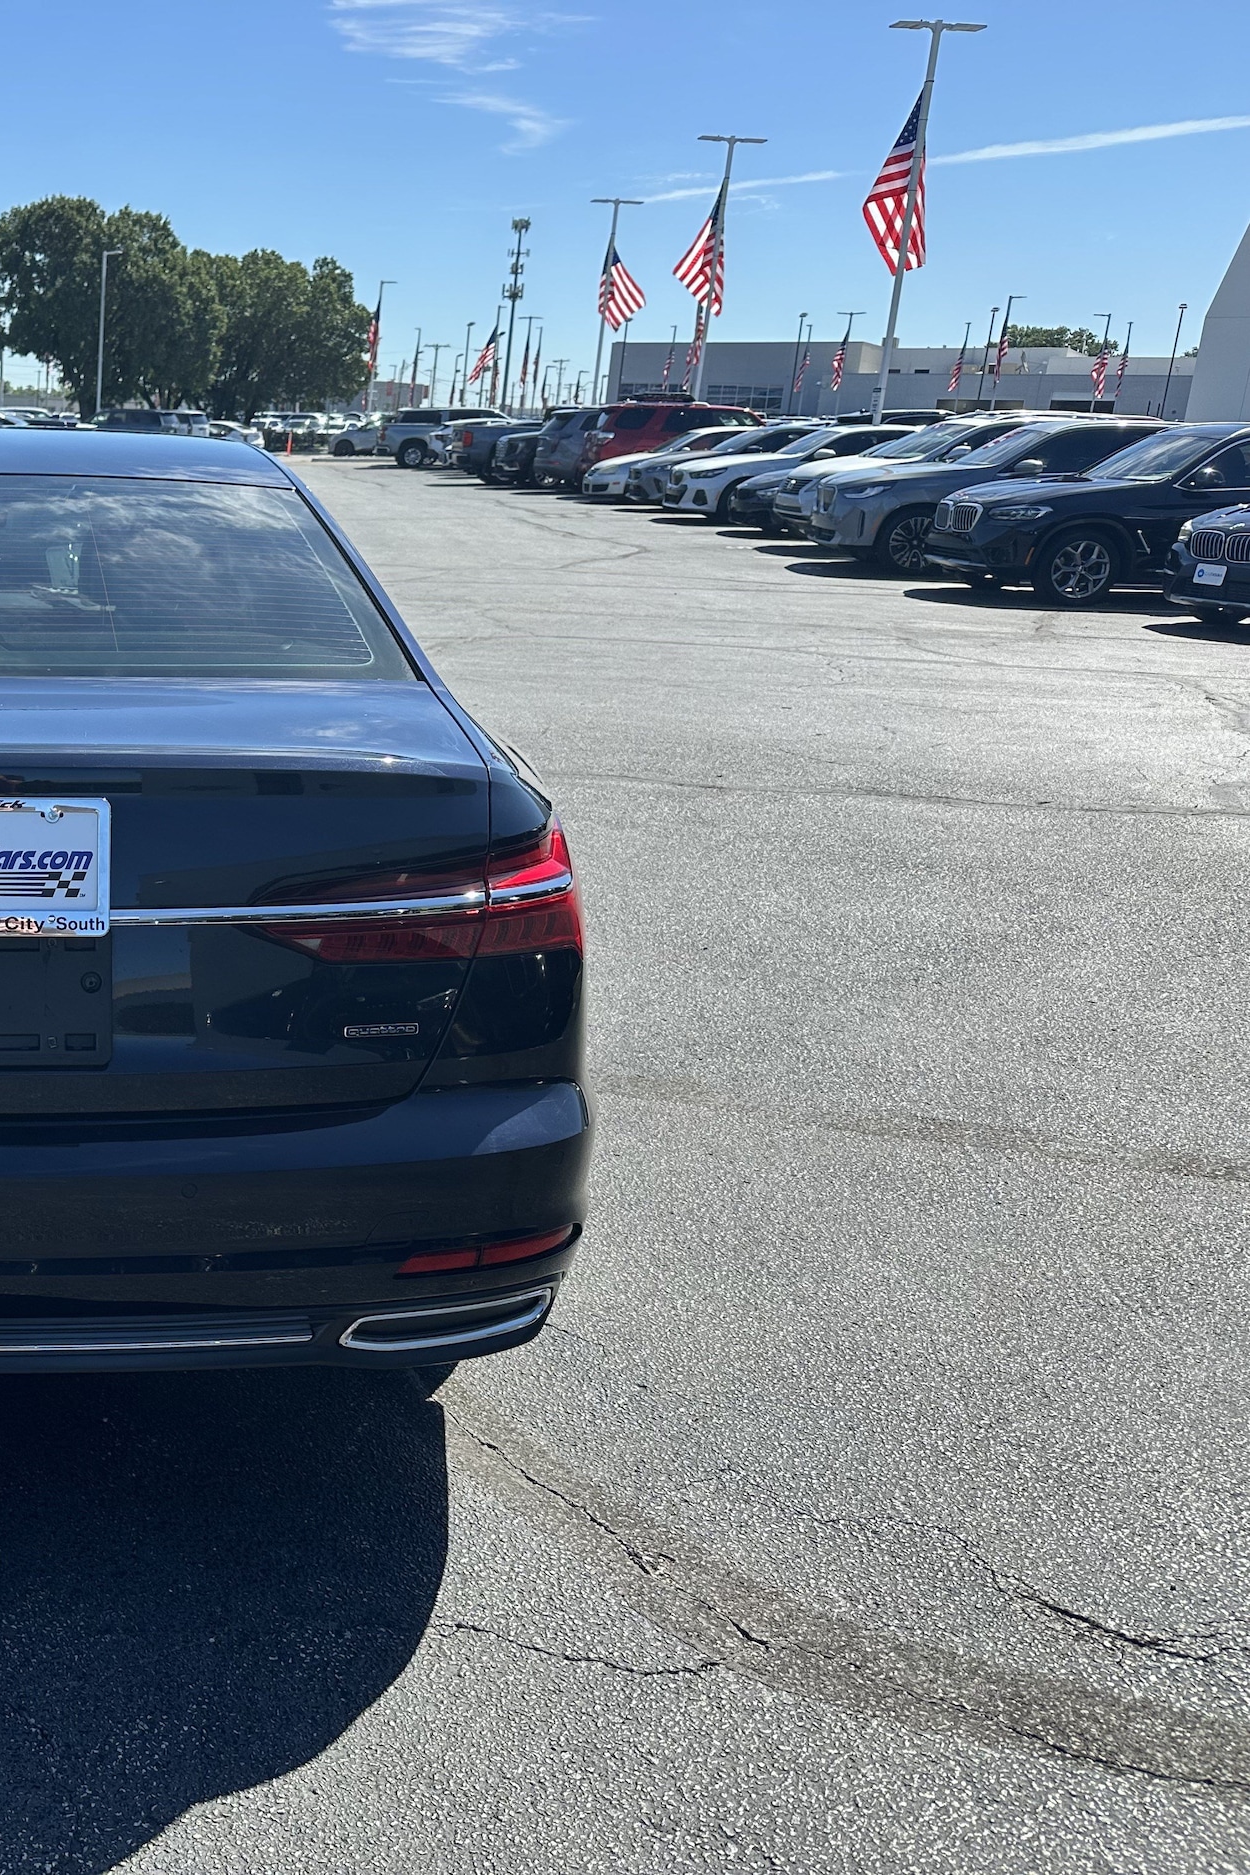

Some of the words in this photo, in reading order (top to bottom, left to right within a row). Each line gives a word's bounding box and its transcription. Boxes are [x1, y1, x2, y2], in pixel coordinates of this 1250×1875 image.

[5, 916, 45, 934] City
[56, 916, 105, 931] South
[348, 1025, 416, 1037] quattro
